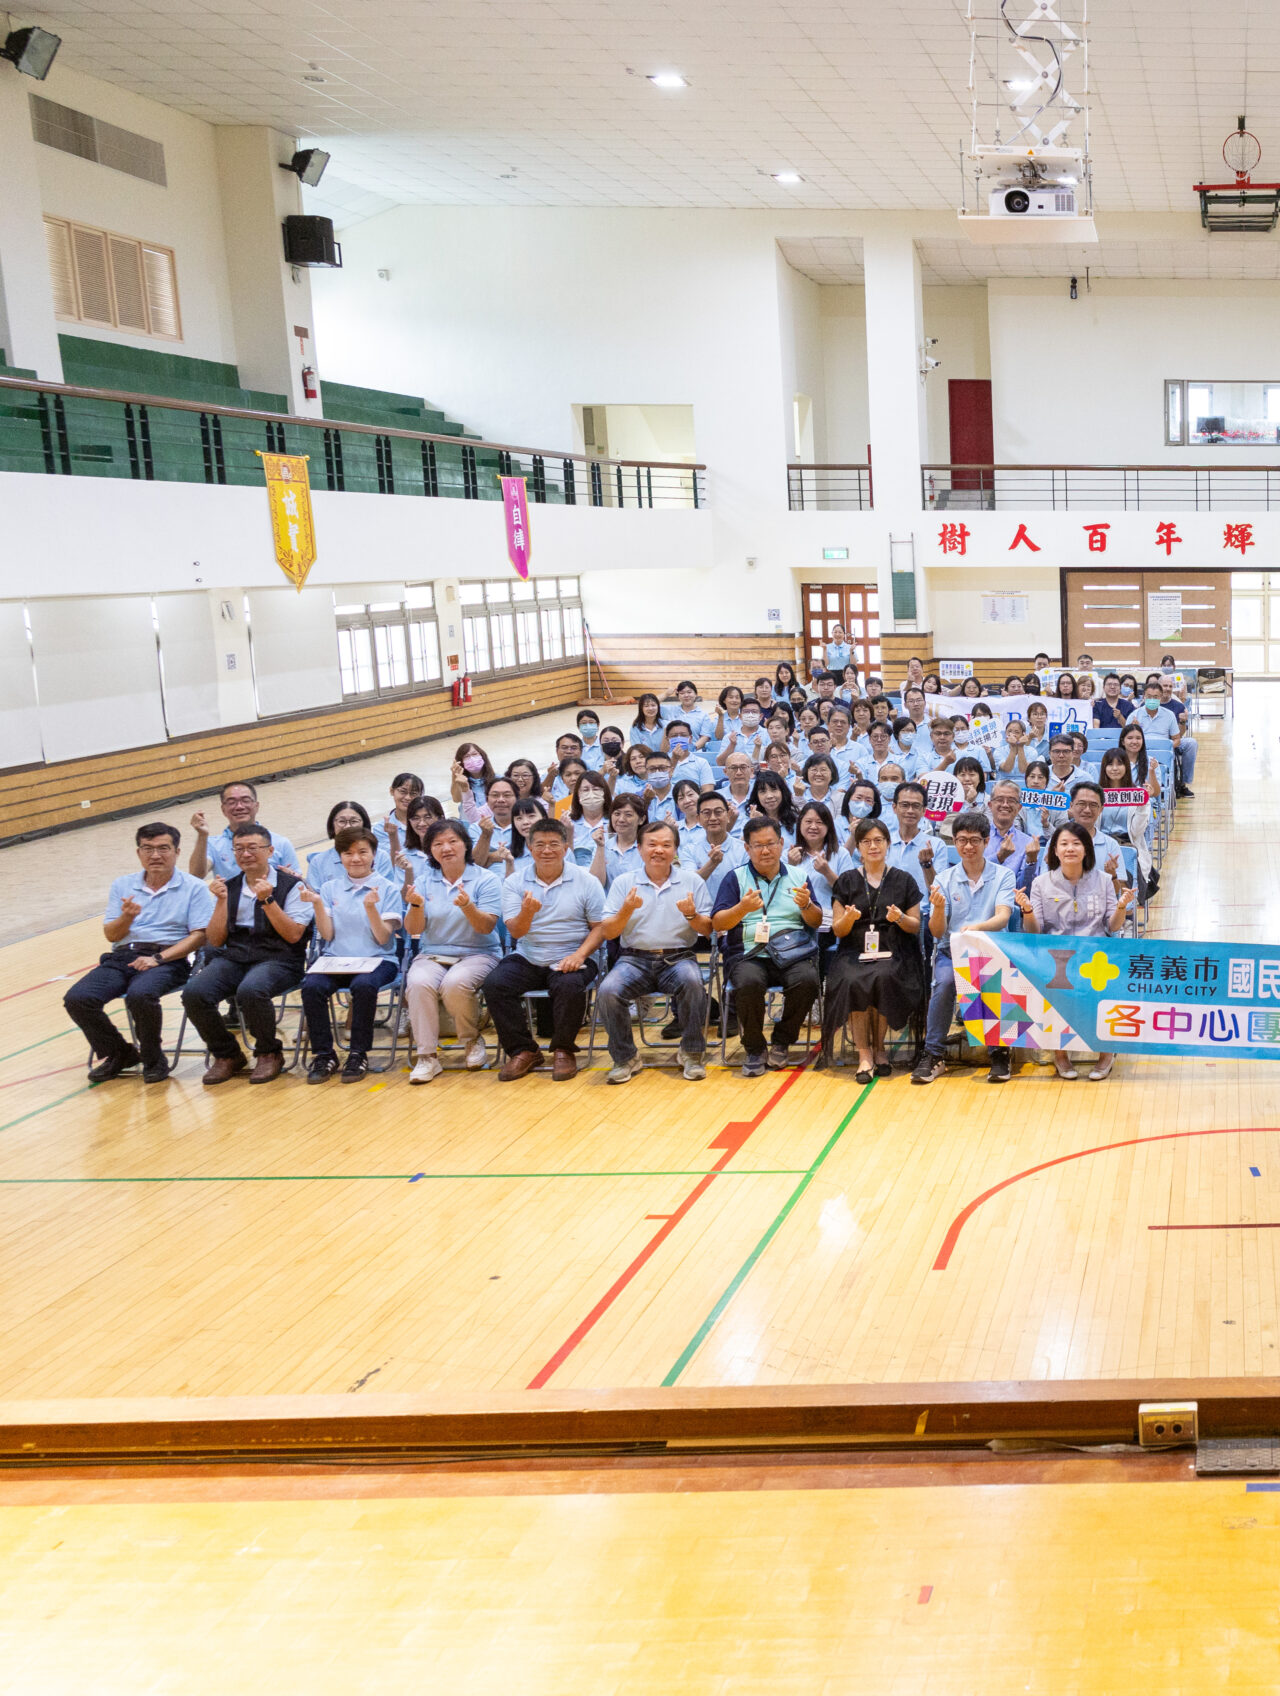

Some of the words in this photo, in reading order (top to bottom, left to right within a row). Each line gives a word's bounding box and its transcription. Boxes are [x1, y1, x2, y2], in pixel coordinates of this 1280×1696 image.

[927, 780, 957, 796] 自我
[928, 796, 954, 812] 實現
[1104, 791, 1145, 803] 緻創新
[1127, 953, 1219, 983] 嘉義市
[1127, 982, 1178, 996] CHIAYI
[1185, 984, 1218, 997] CITY
